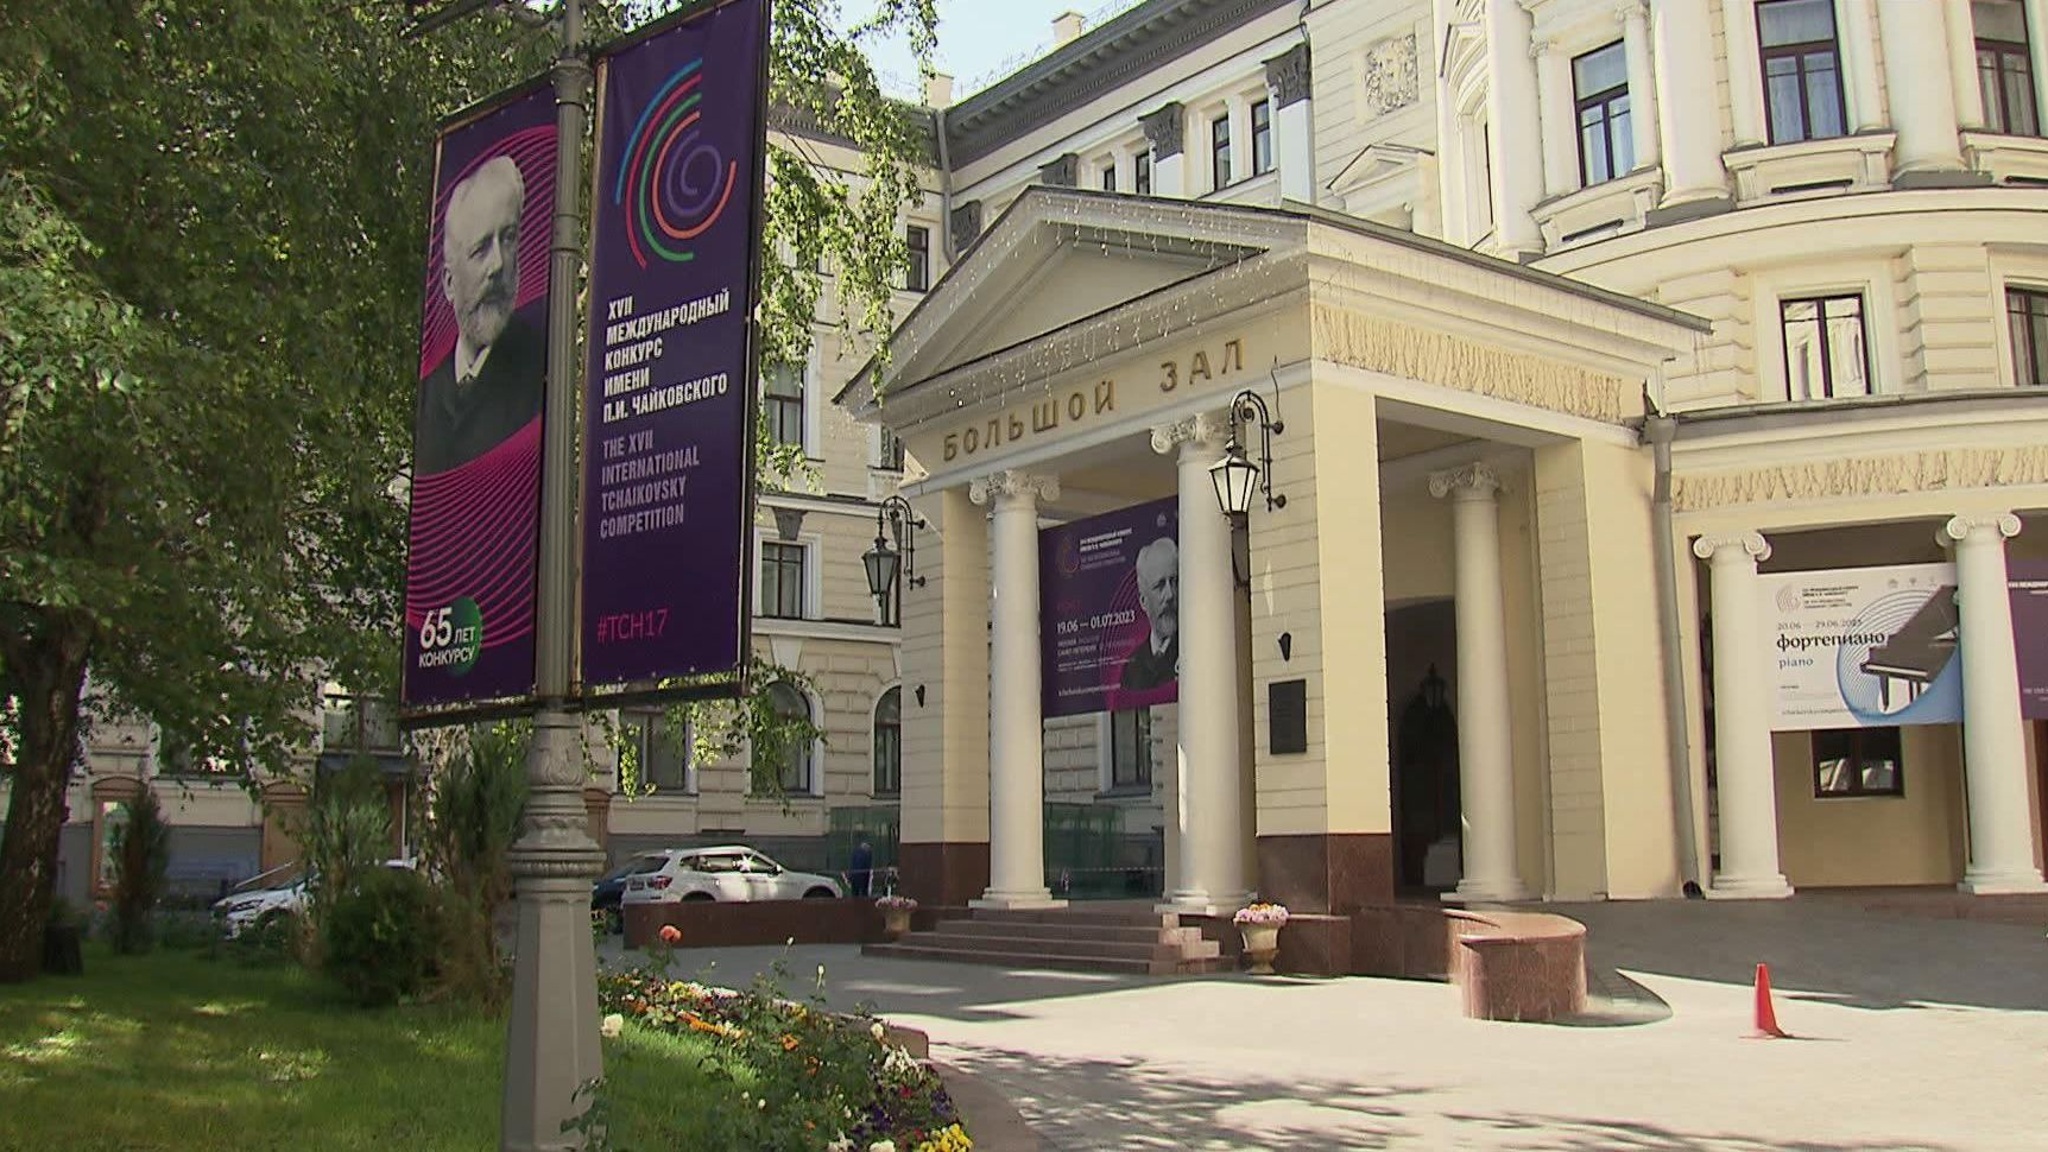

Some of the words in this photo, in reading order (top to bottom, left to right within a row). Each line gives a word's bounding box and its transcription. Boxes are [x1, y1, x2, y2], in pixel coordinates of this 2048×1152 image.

[606, 287, 730, 346] МЕЖДУНАРОДНЫЙ
[608, 295, 633, 320] XVII
[605, 338, 663, 371] КОНКУРС
[603, 401, 628, 423] П.И.
[632, 373, 728, 416] ЧАЙКОВСКОГО
[604, 367, 650, 397] ИМЕНИ
[943, 380, 1116, 461] БОЛЬШОЙ
[1160, 338, 1245, 392] ЗАЛ
[603, 436, 625, 459] THE
[628, 430, 653, 454] XVII
[602, 445, 700, 485] INTERNATIONAL
[602, 476, 686, 511] TCHAIKOVSKY
[600, 504, 684, 539] COMPETITION
[420, 607, 453, 649] 65
[454, 626, 476, 644] ЛЕТ
[597, 609, 669, 643] #TCH17
[1090, 610, 1136, 629] 01.07.2023
[419, 646, 476, 668] КОНКУРСУ
[1777, 632, 1885, 652] фортепиано
[1779, 657, 1814, 670] piano
